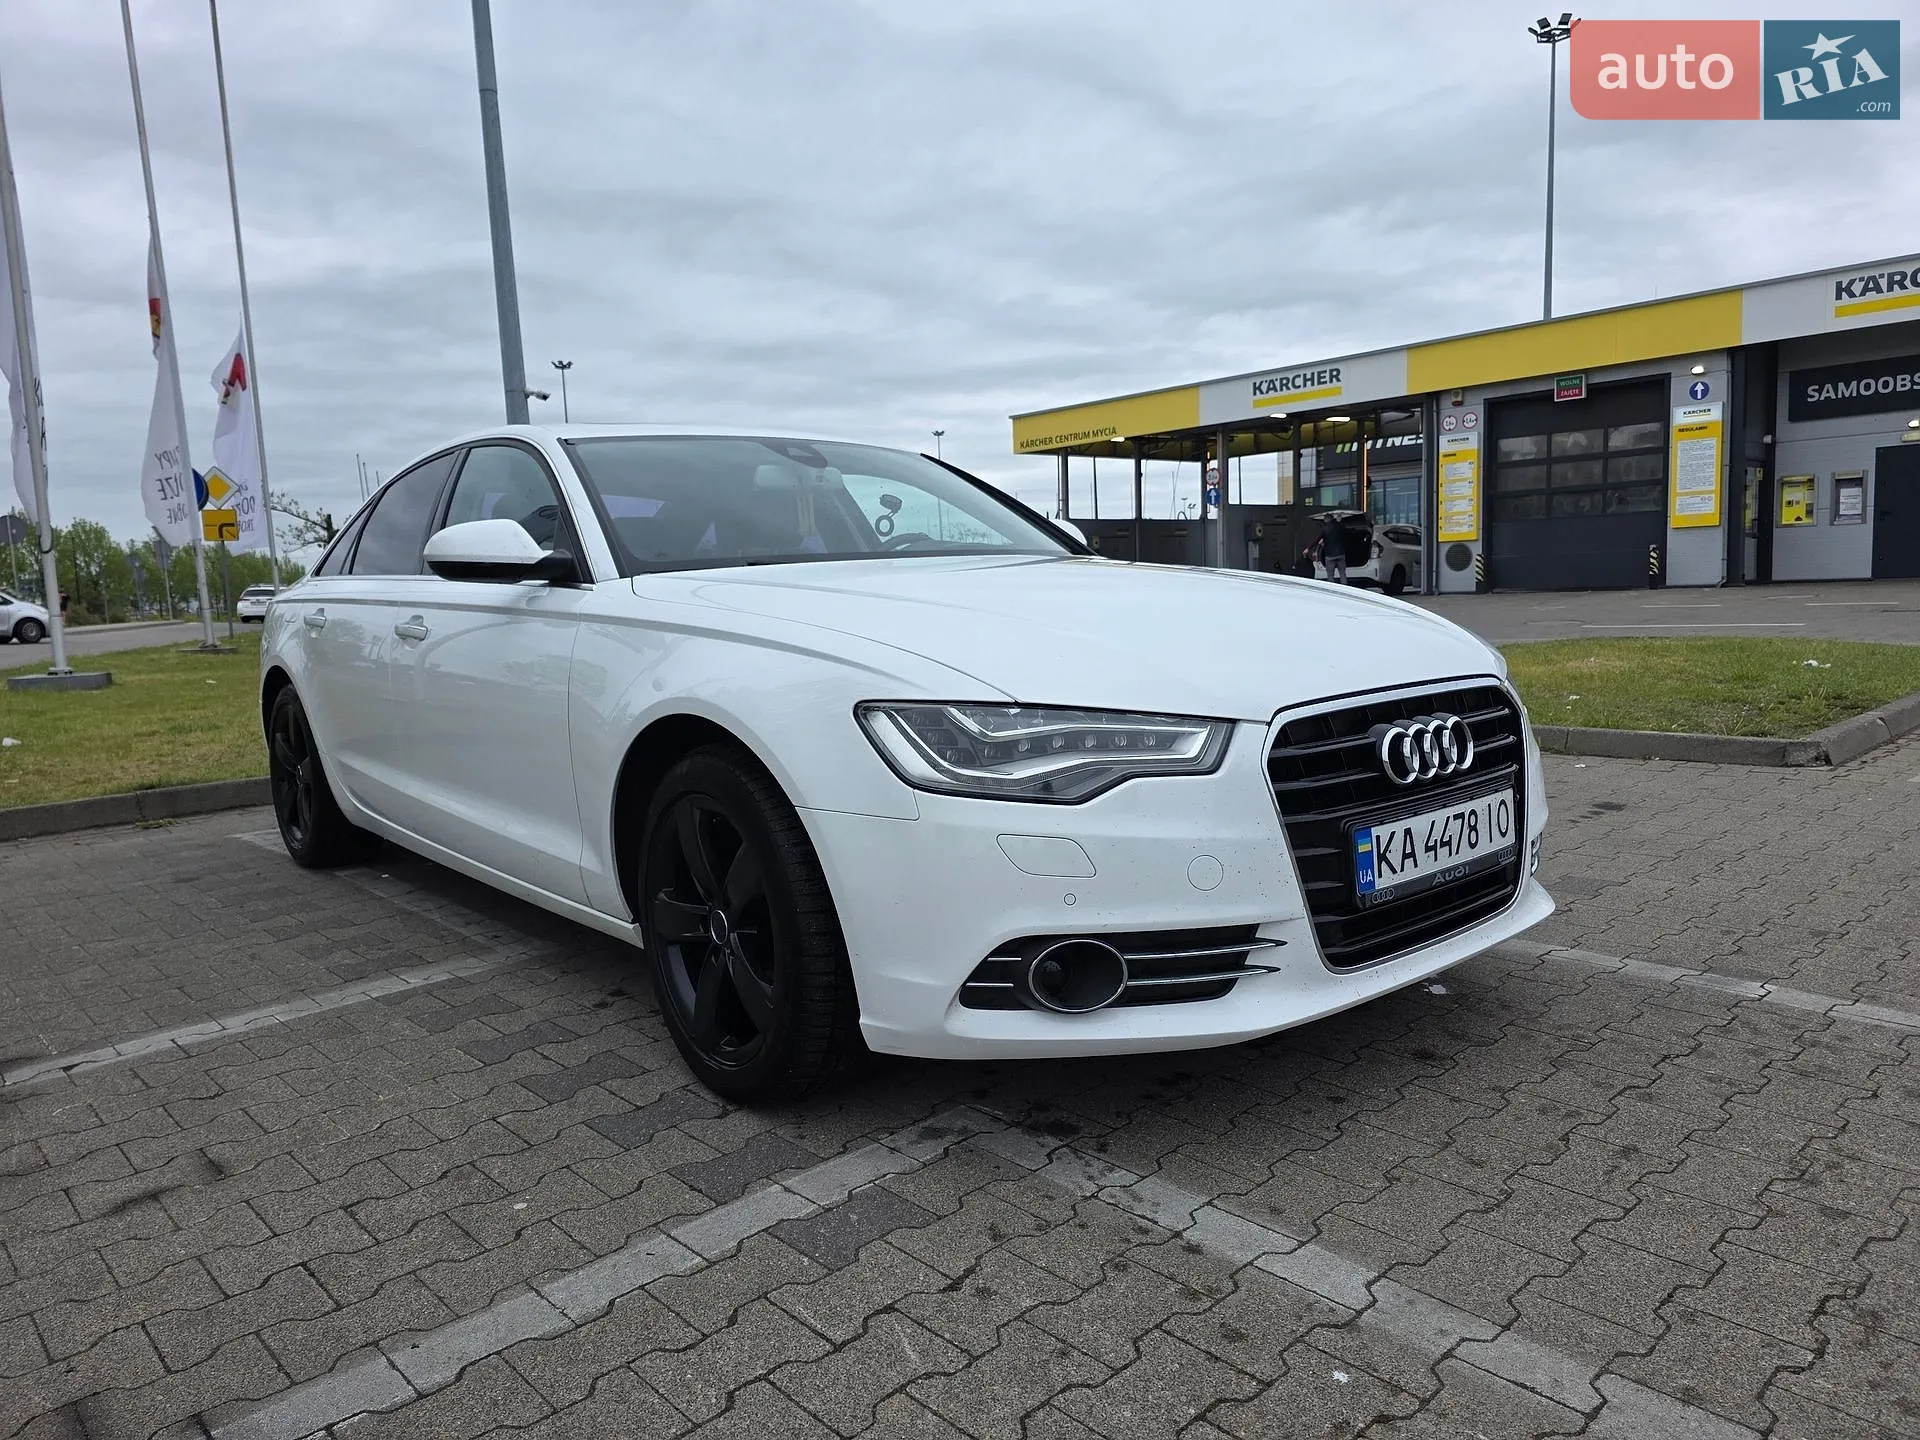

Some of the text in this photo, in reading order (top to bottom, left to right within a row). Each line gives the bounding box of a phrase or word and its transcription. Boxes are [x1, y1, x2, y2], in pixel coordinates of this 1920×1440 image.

[1252, 367, 1342, 396] KÄRCHER
[1054, 430, 1091, 445] CENTRUM
[1091, 426, 1118, 440] MYCIA
[1375, 798, 1510, 879] KA 4478 IO
[1359, 869, 1374, 884] UA
[1431, 864, 1470, 887] Audi
